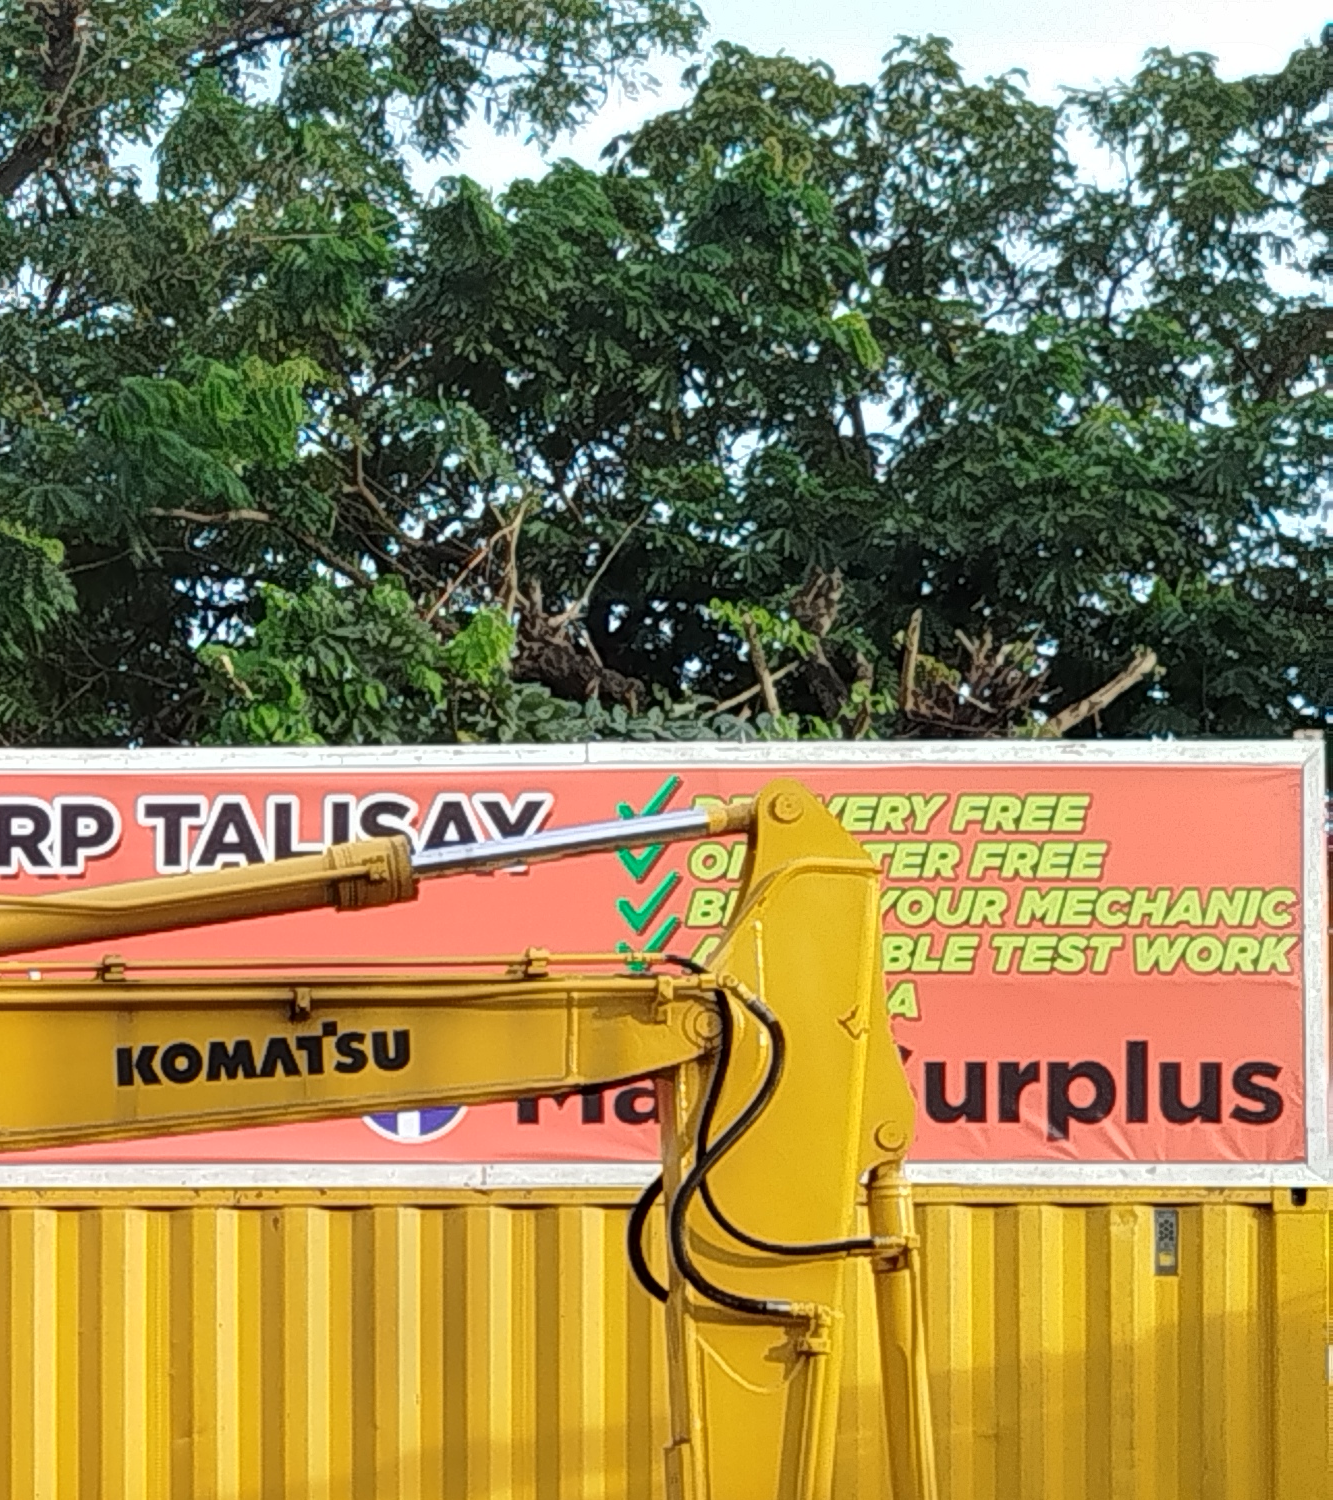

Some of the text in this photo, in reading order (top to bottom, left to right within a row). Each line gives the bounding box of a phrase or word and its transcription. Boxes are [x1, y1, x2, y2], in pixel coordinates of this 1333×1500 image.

[142, 799, 548, 869] TALISAY
[950, 793, 1092, 834] FREE
[966, 841, 1109, 881] FREE
[1015, 887, 1298, 928] MECHANIC
[990, 934, 1124, 974] TEST
[1132, 934, 1298, 974] WORK
[115, 1020, 412, 1087] KOMATSU
[897, 1039, 1285, 1143] urplus
